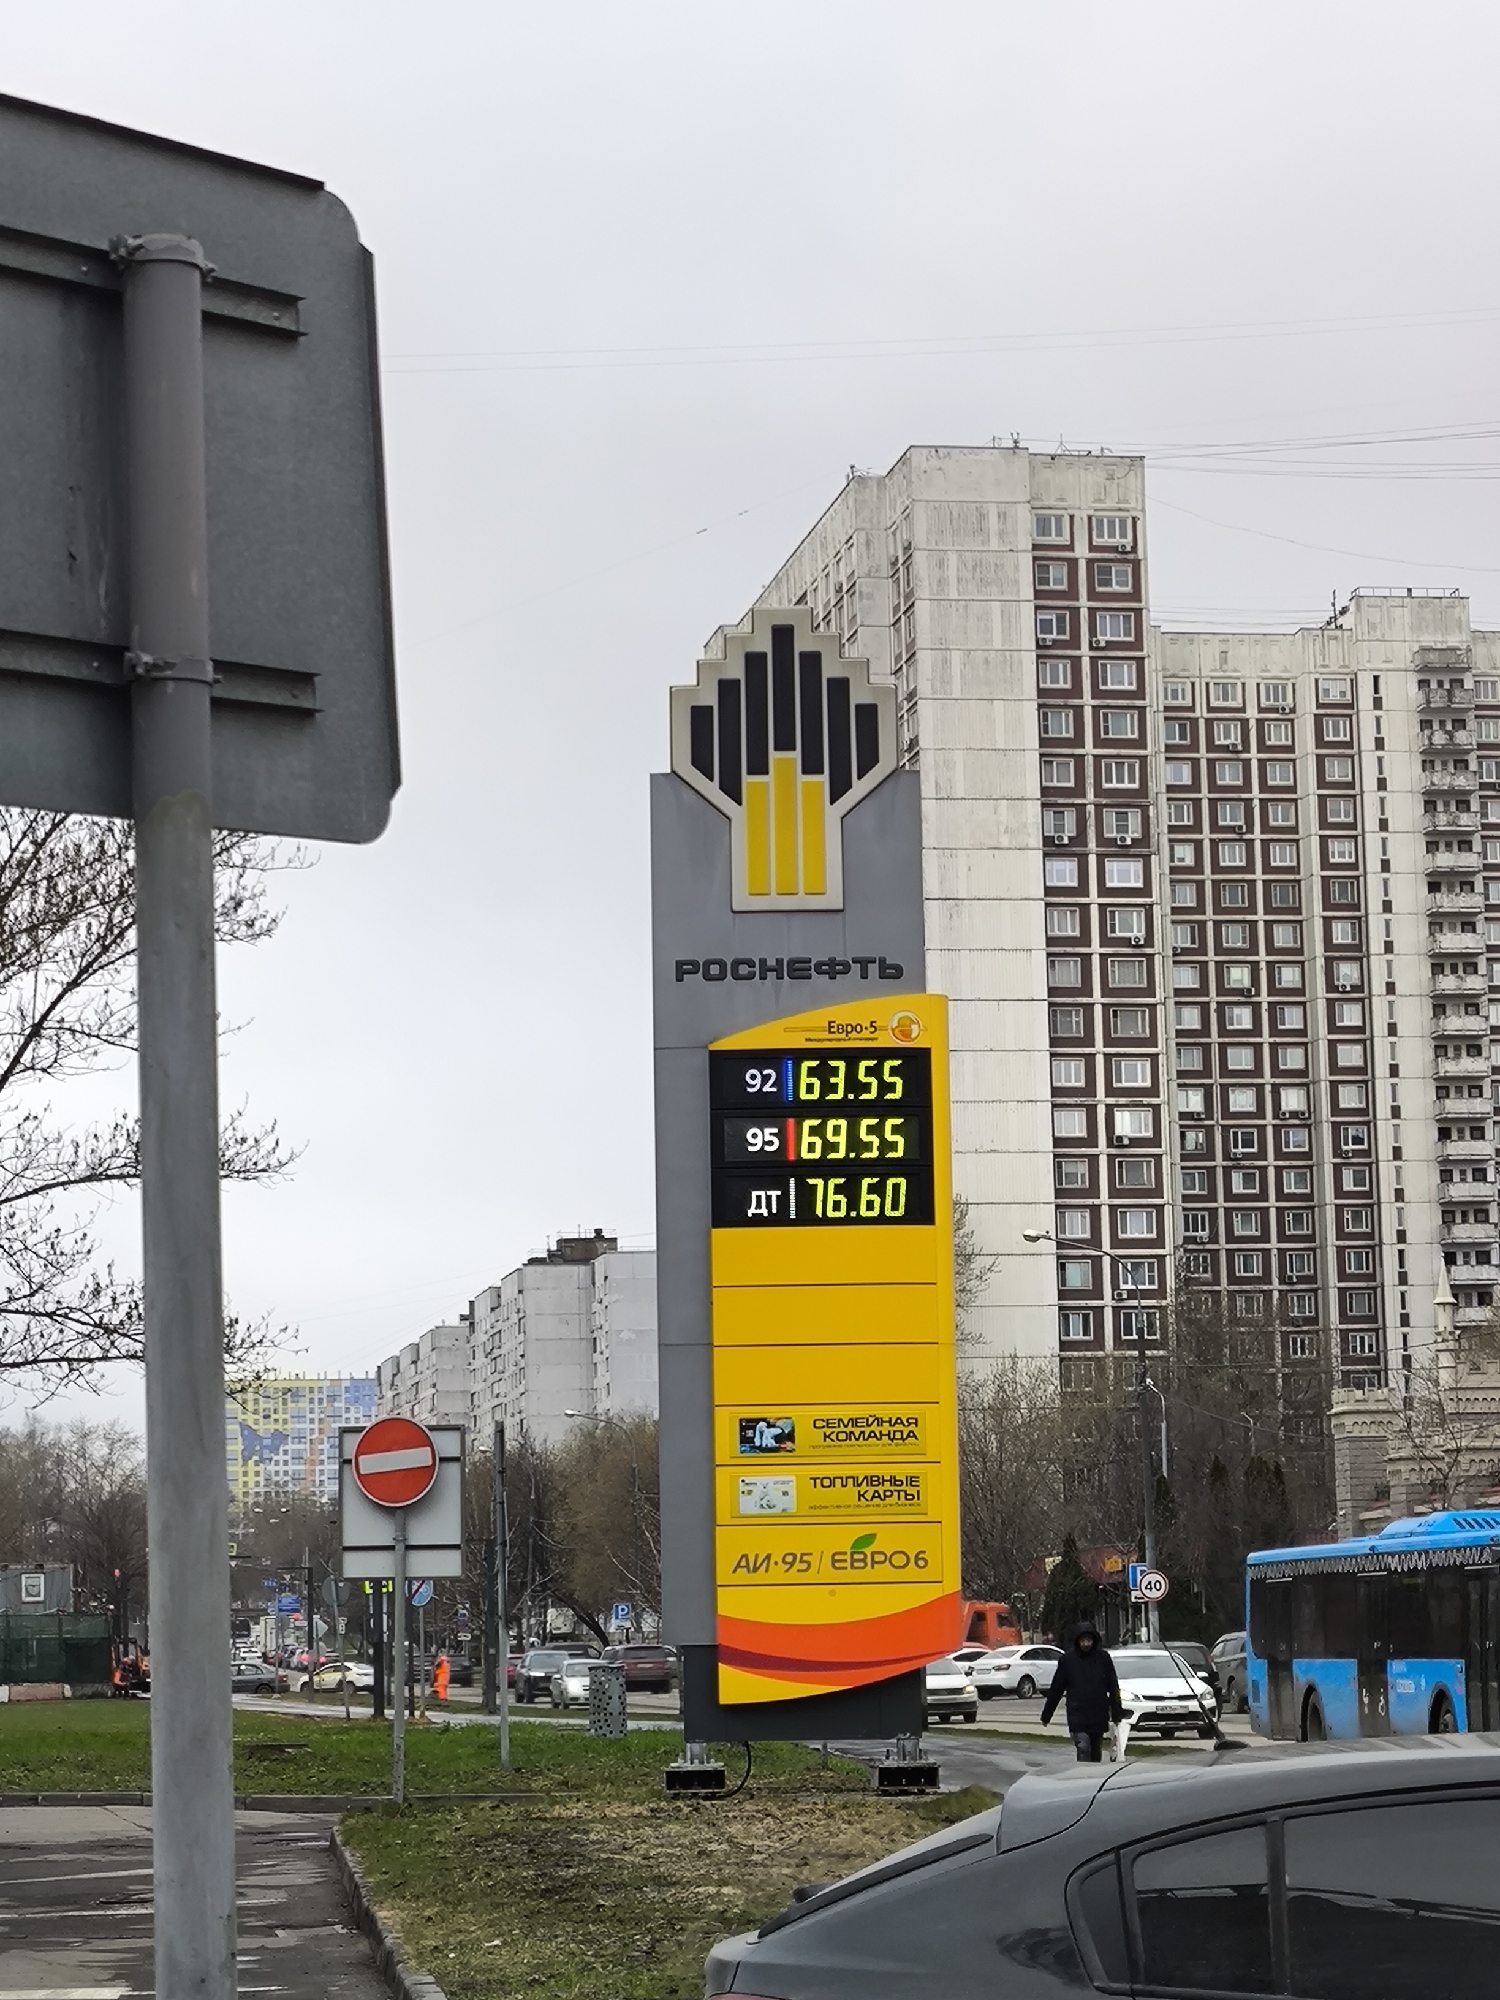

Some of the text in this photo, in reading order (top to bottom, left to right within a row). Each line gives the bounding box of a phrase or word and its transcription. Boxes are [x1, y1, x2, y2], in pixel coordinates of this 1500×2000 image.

[675, 956, 904, 982] РОСНЕФТЬ
[745, 1060, 904, 1101] 92 63.55
[745, 1118, 905, 1159] 95 69.55
[747, 1177, 907, 1218] ДТ 76.60
[813, 1414, 918, 1429] СЕМЕЙНАЯ
[823, 1430, 919, 1443] КОМАНДА
[809, 1475, 920, 1489] ТОПЛИВНЫЕ
[857, 1489, 920, 1502] КАРТЫ
[1144, 1579, 1162, 1592] 40
